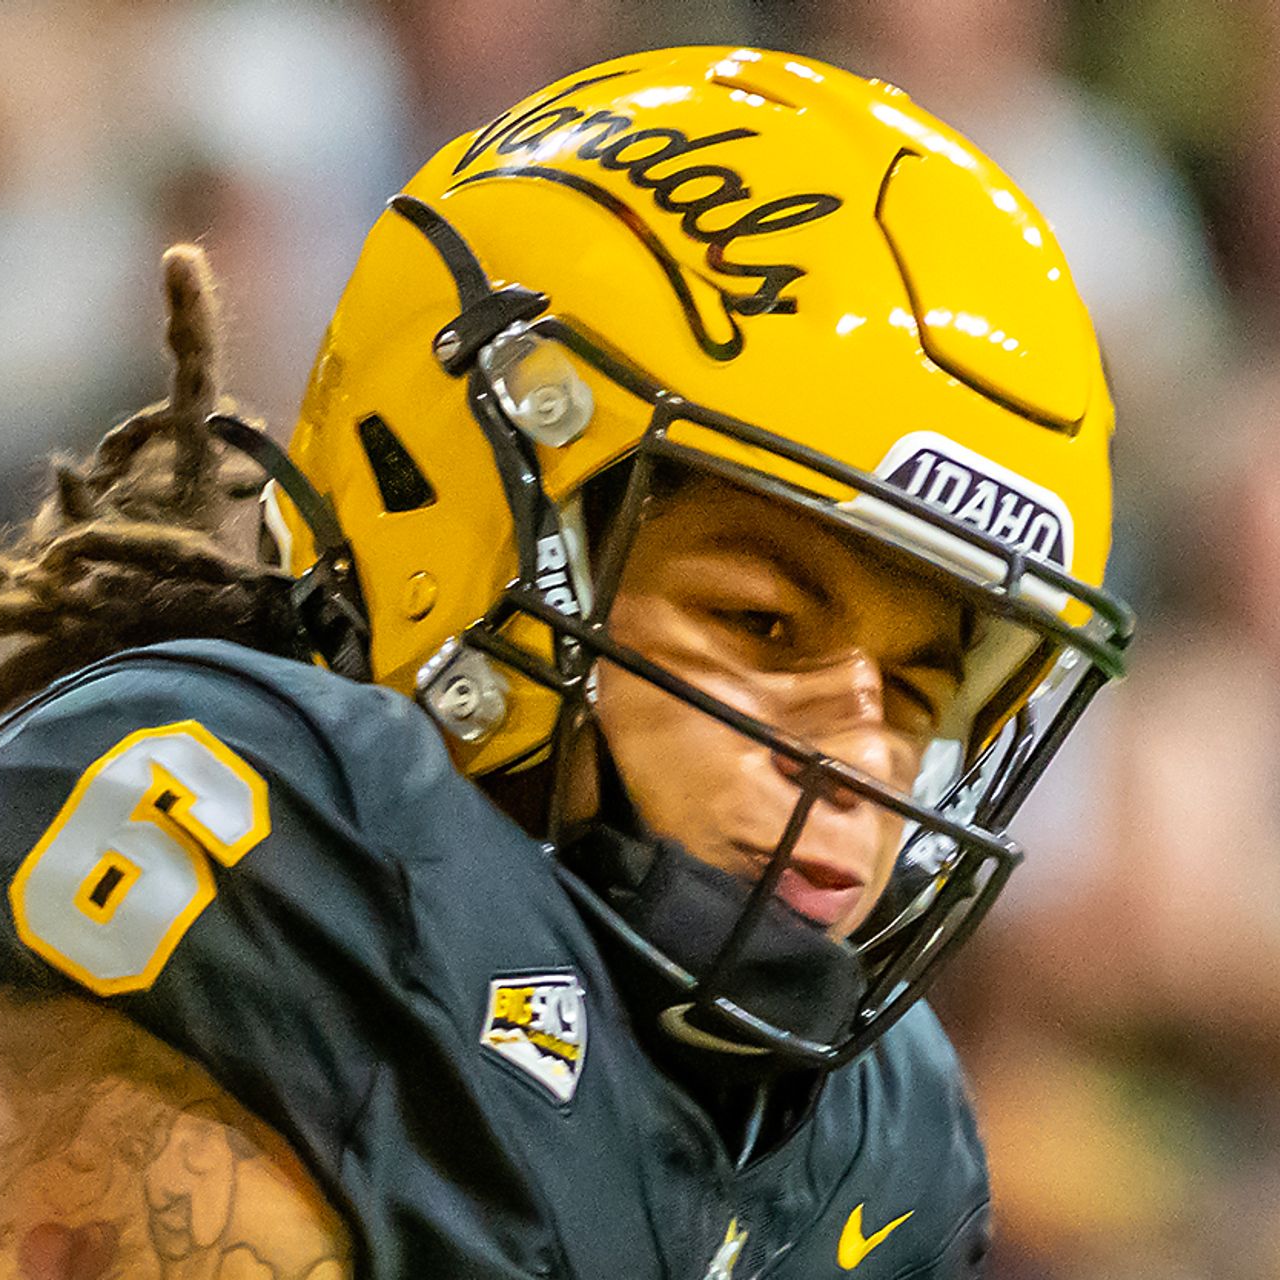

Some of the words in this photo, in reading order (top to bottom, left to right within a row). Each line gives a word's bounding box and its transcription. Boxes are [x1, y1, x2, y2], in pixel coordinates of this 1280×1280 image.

[452, 69, 843, 316] Vandals
[905, 450, 1062, 563] IDAHO
[8, 719, 272, 998] 6
